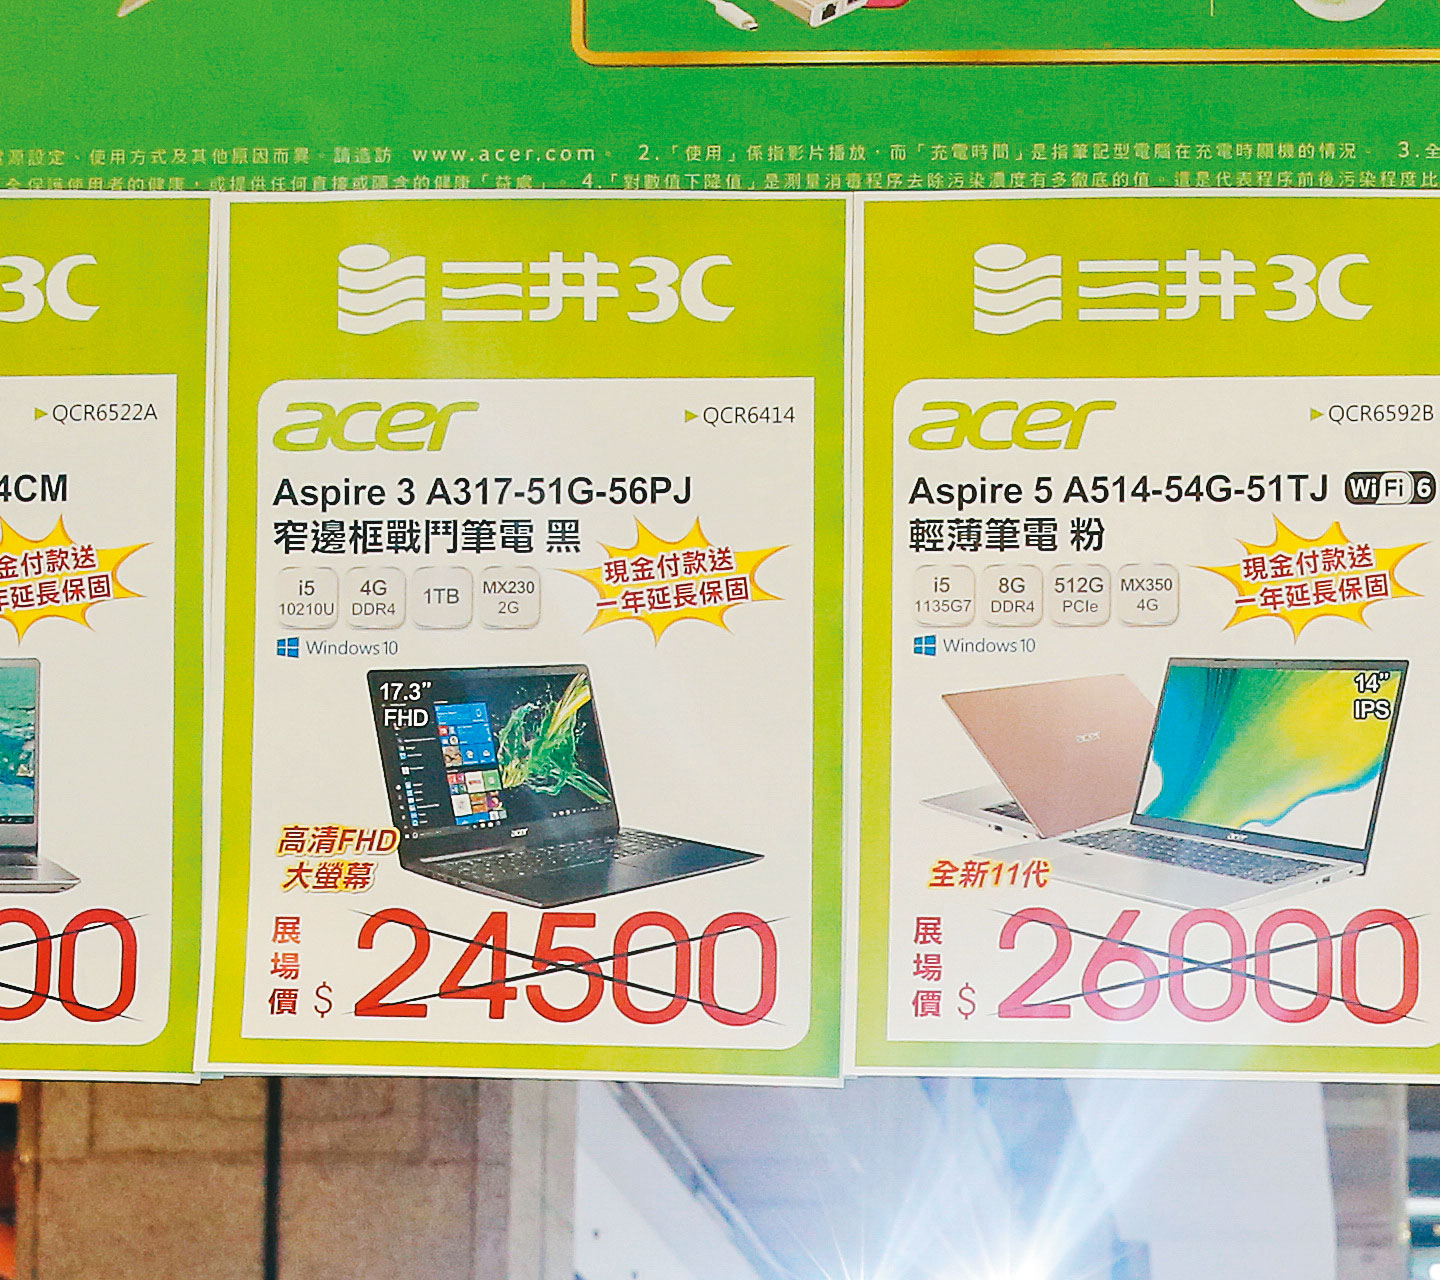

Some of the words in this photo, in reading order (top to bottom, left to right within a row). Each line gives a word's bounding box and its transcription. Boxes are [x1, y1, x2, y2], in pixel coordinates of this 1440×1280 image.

[441, 250, 735, 324] 三井3C
[1078, 248, 1374, 322] 三井3C
[52, 403, 158, 424] QCR6522A
[272, 401, 480, 452] acer
[702, 405, 796, 427] QCR6414
[908, 400, 1117, 451] acer
[1328, 404, 1435, 424] QCR6592B
[272, 477, 387, 513] Aspire
[396, 477, 416, 506] 3
[426, 476, 692, 507] A317-51G-56PJ
[908, 476, 1023, 511] Aspire
[1034, 476, 1054, 504] 5
[1063, 474, 1330, 505] A514-54G-51TJ
[273, 519, 535, 555] 窄邊框戰鬥筆電
[546, 519, 581, 555] 黑
[908, 518, 1058, 553] 輕薄筆電
[1070, 518, 1106, 553] 粉
[423, 588, 460, 605] 1TB
[482, 579, 535, 596] MX230
[278, 601, 335, 618] 10210U
[383, 708, 429, 728] FHD
[277, 825, 399, 856] 高清FHD
[282, 862, 377, 891] 大螢幕
[930, 860, 1050, 890] 全新11代
[268, 916, 301, 1018] 展場價
[354, 907, 778, 1028] 24500
[912, 916, 943, 1019] 展場價
